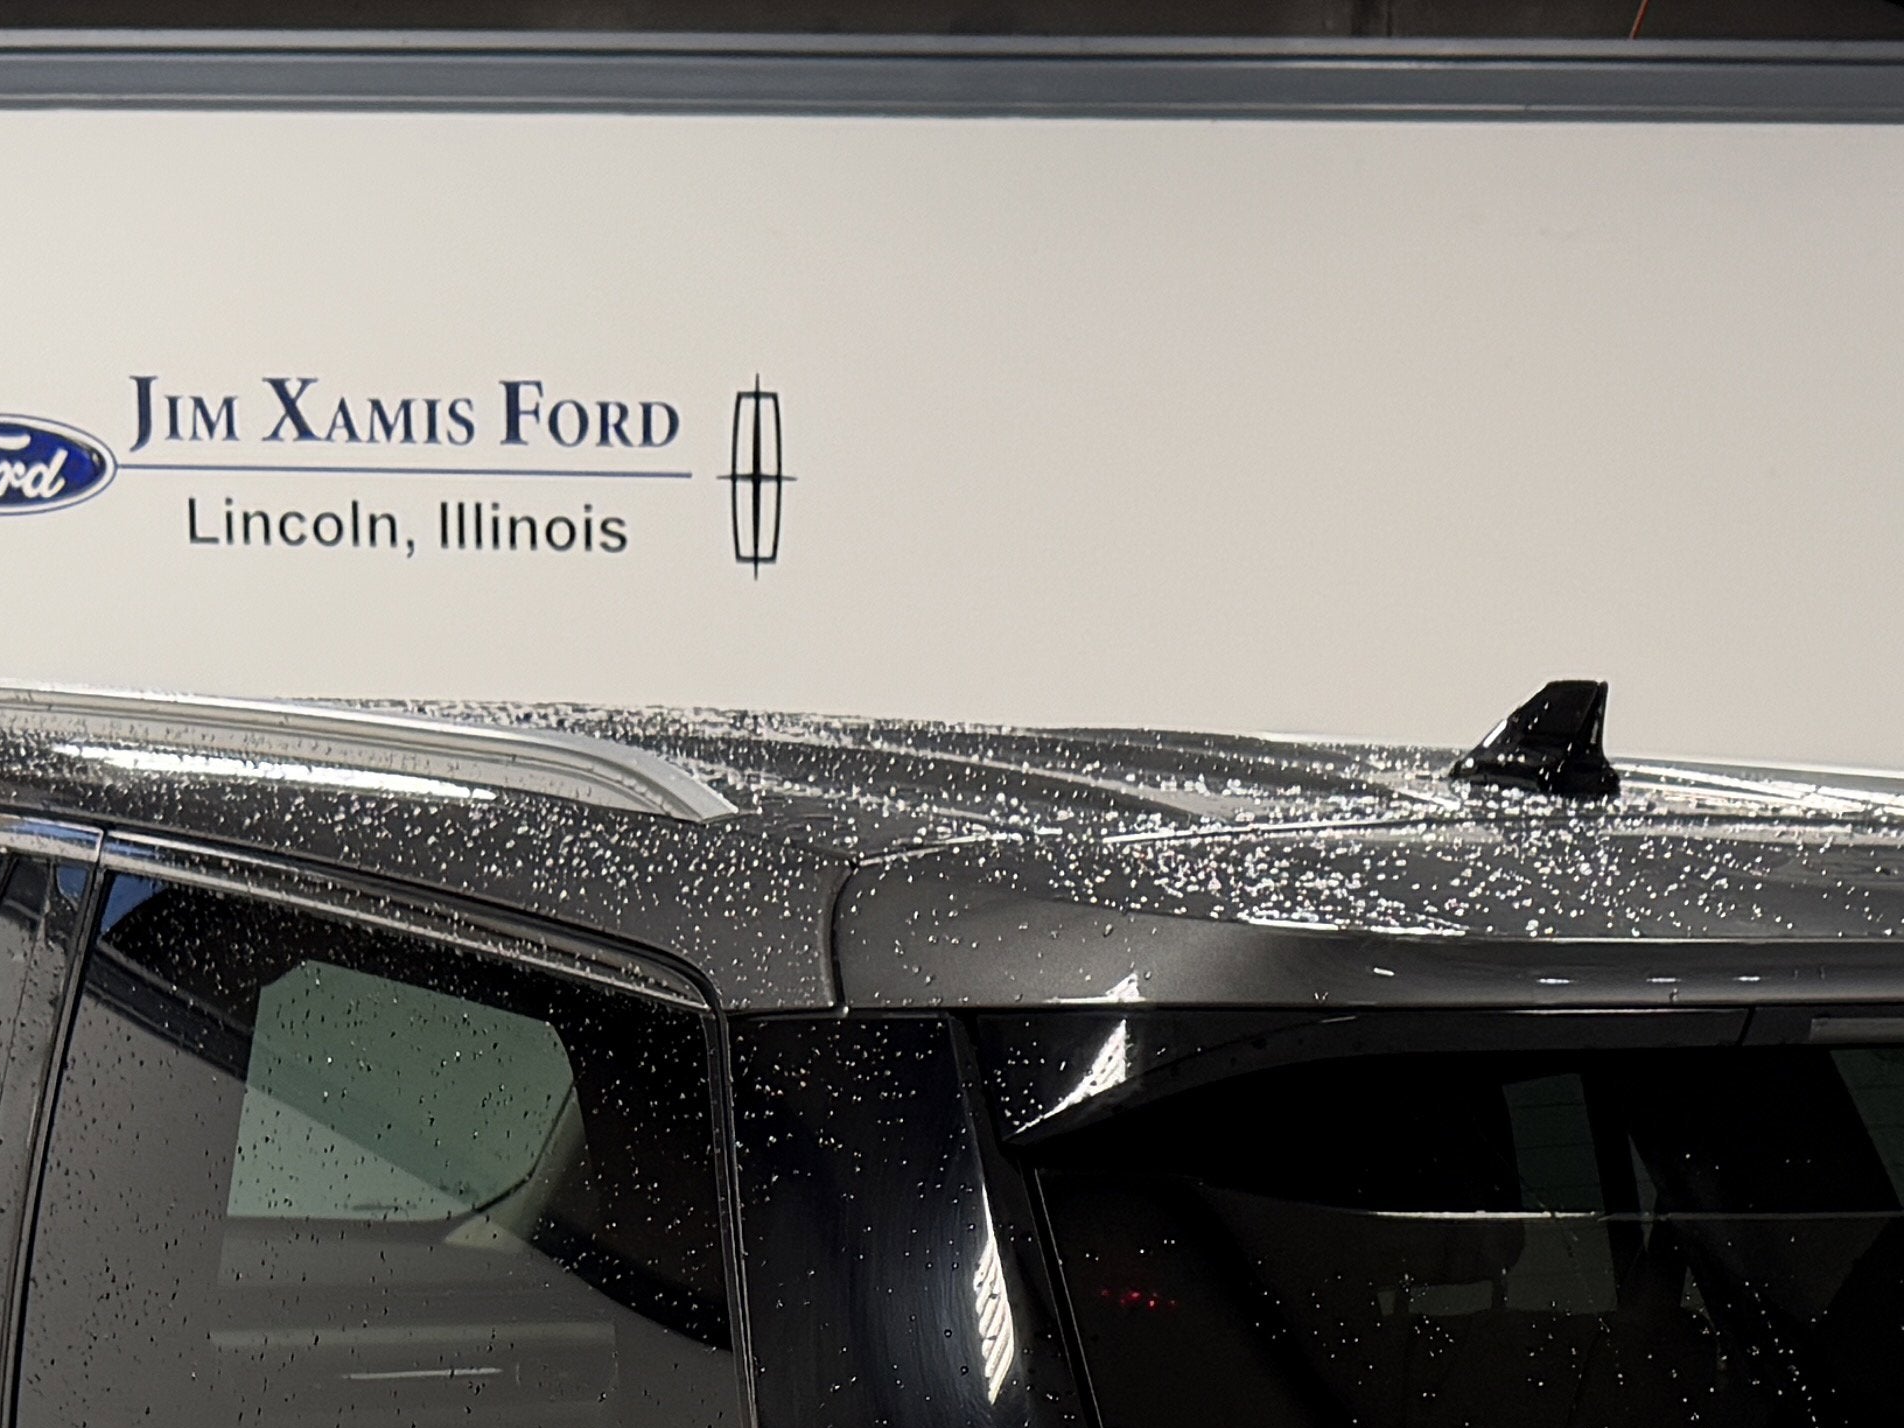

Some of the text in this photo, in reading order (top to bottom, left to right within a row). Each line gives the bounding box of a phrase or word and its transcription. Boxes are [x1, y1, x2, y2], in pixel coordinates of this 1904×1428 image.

[127, 374, 681, 453] JIM XAMIS FORD
[188, 498, 628, 558] Lincoln, Illinois
